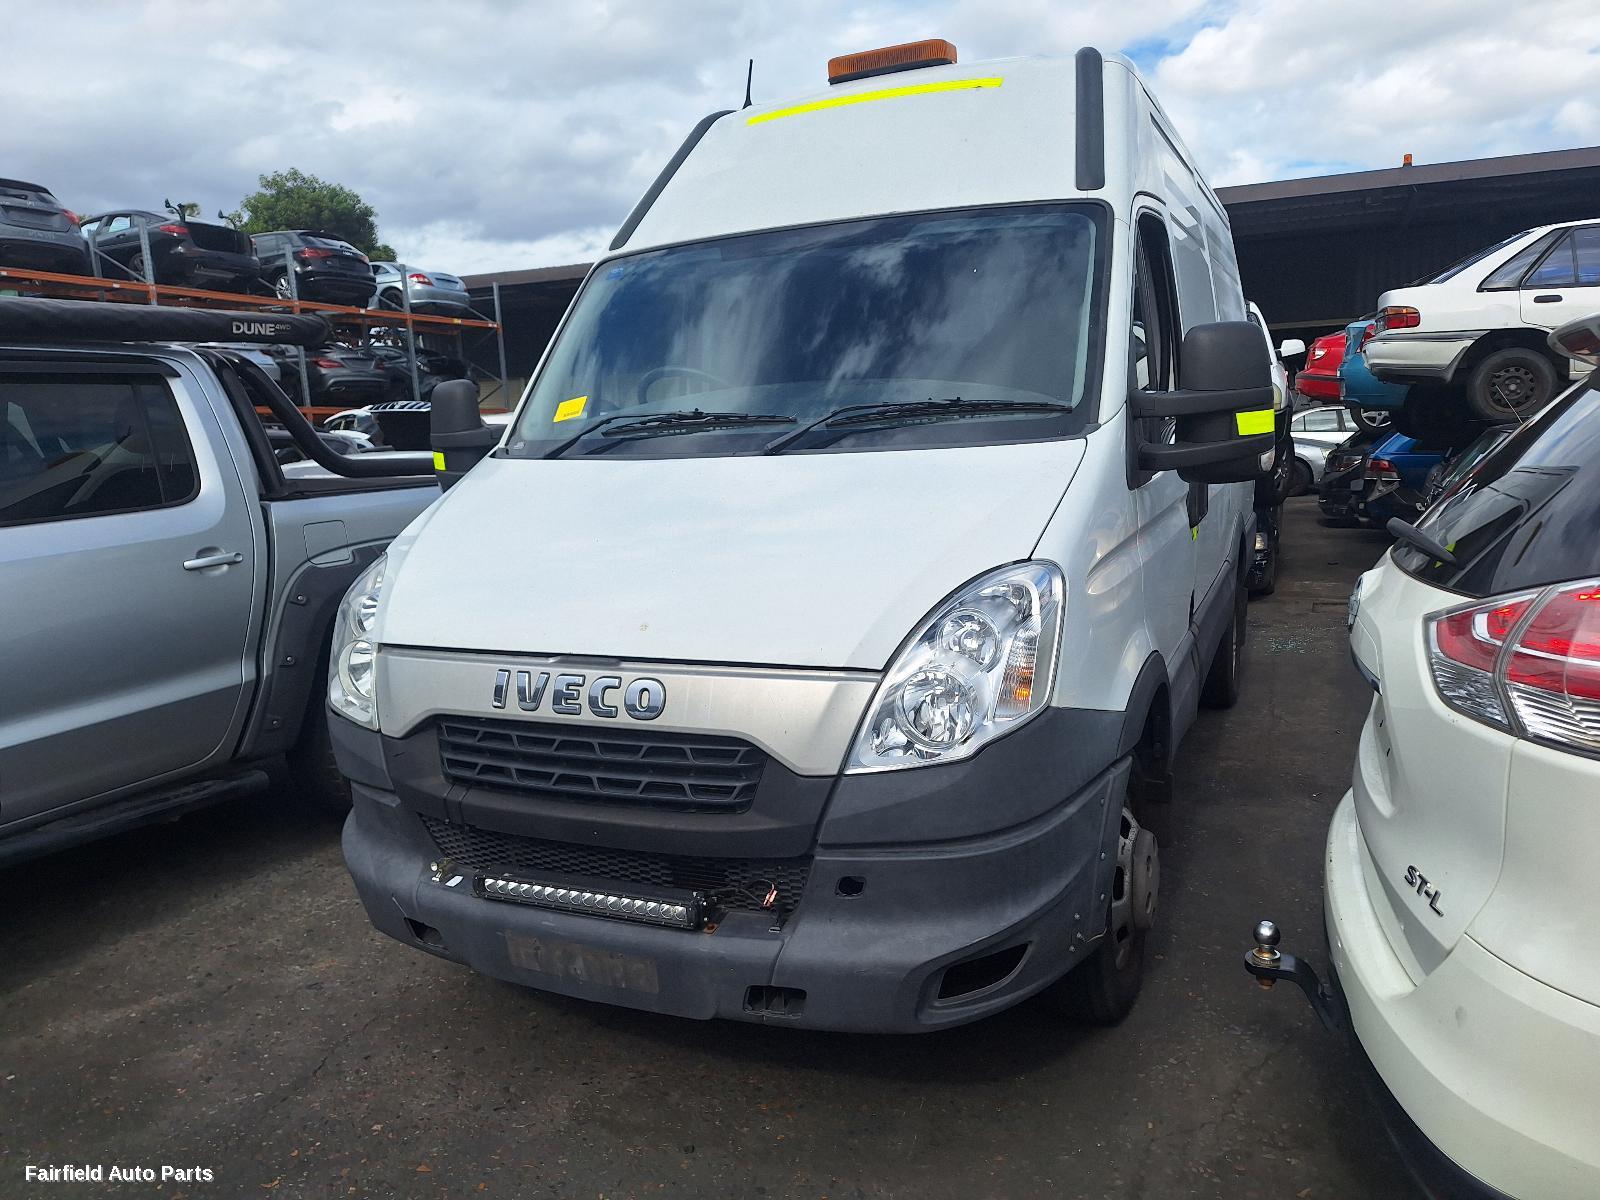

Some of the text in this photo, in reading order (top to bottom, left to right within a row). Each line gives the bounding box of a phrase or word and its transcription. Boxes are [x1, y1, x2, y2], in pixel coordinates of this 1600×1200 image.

[232, 321, 275, 335] DUNE
[492, 669, 667, 720] IVECO
[1404, 865, 1444, 917] ST-L
